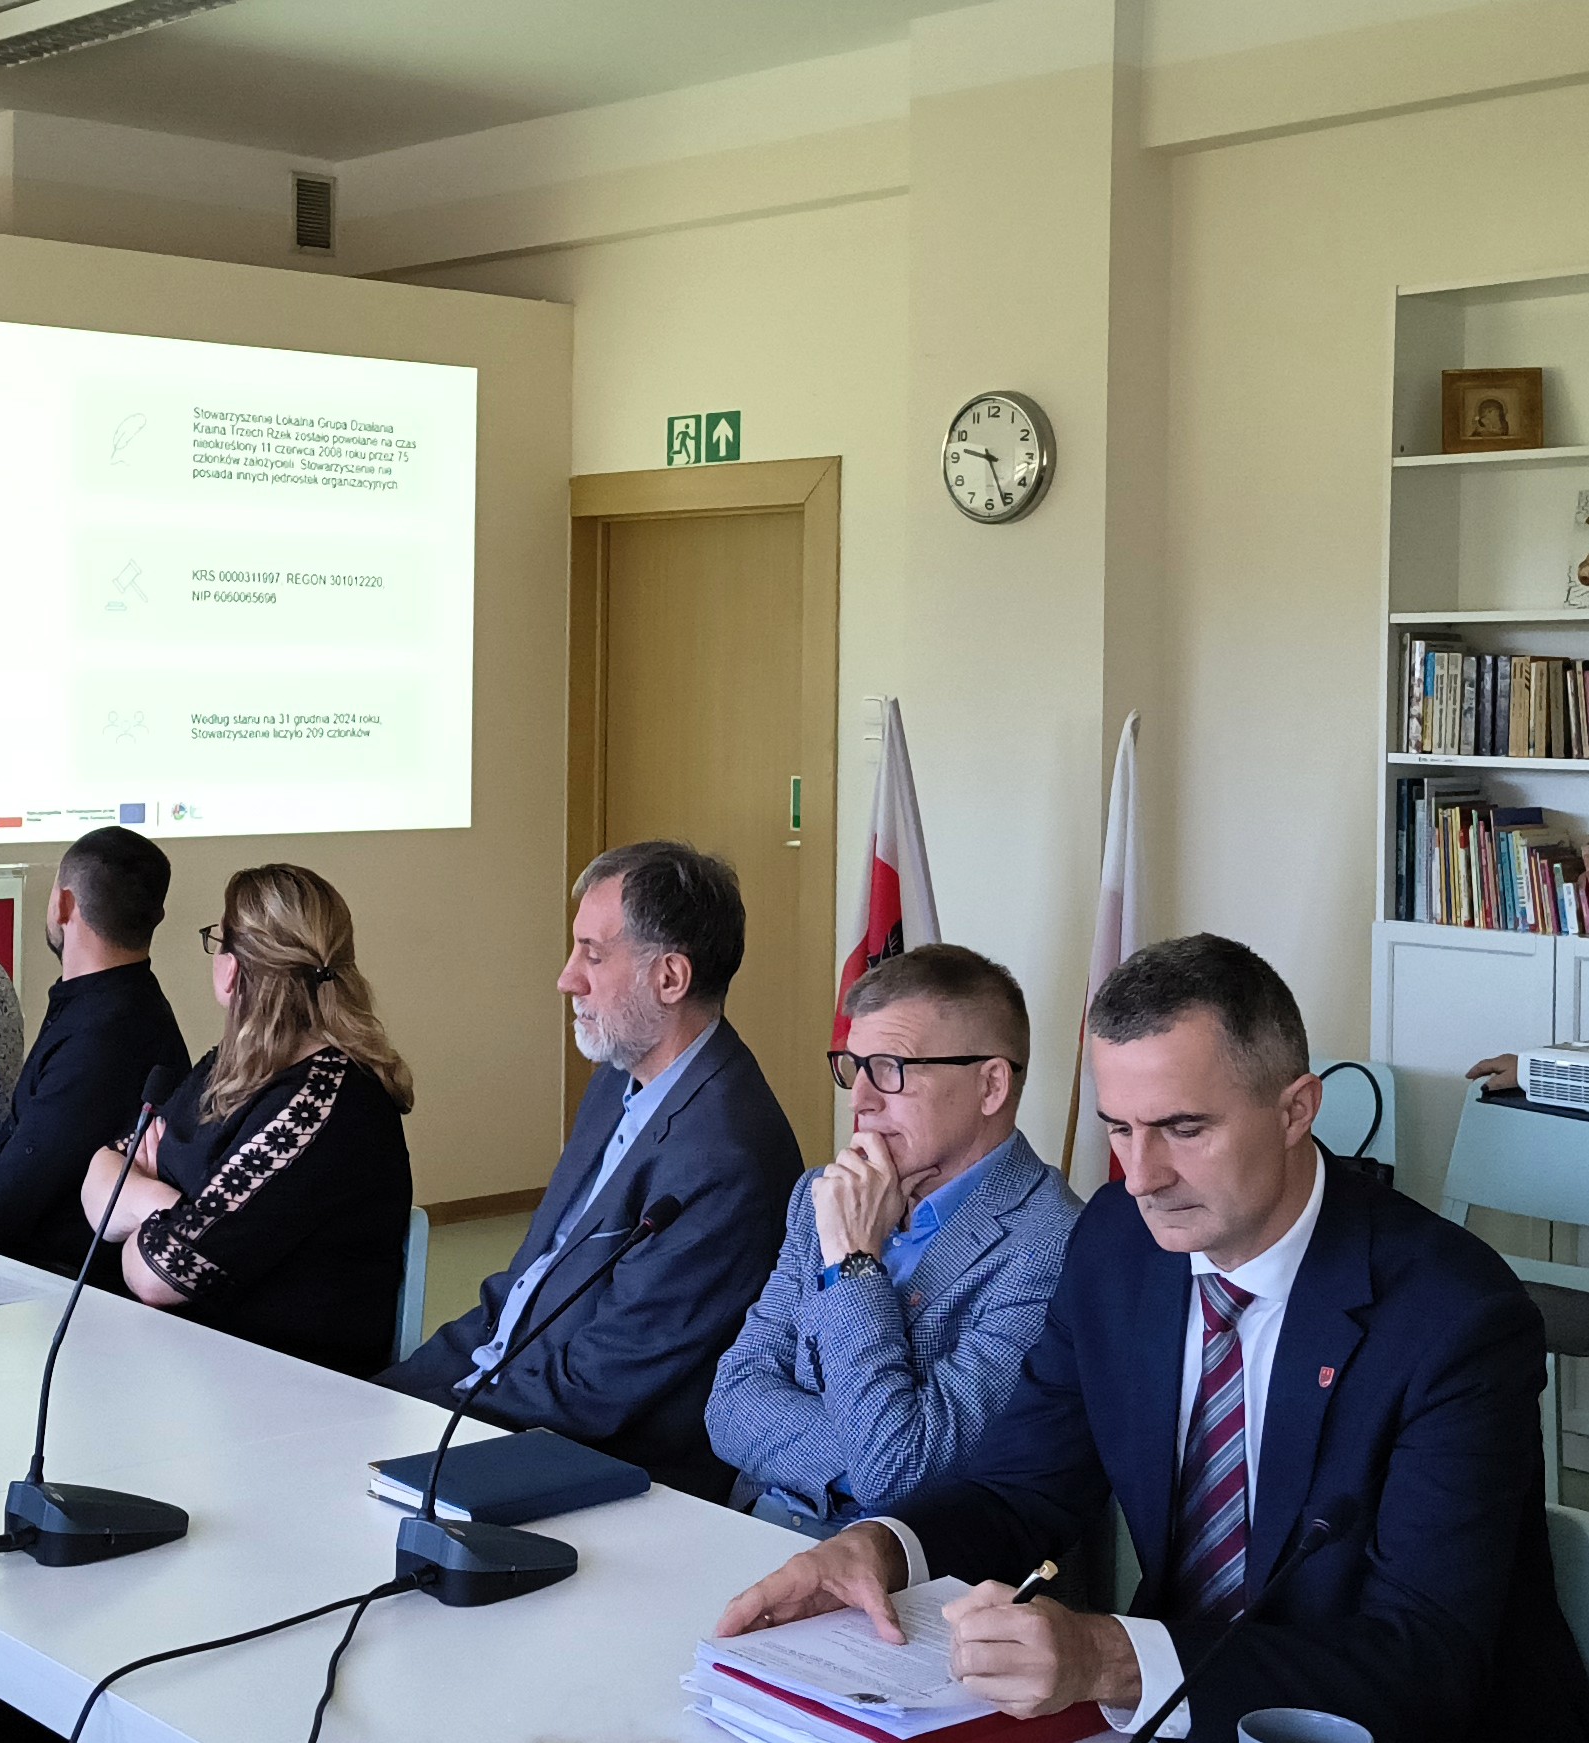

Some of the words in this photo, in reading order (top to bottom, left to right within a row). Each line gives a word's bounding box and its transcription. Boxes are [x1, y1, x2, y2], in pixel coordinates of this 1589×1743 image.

[973, 412, 980, 424] 11
[988, 405, 1001, 418] 12
[1012, 411, 1015, 424] 1
[193, 407, 273, 425] Stowarzyszenie
[276, 414, 315, 428] Lokalna
[317, 417, 348, 431] Grupa
[193, 422, 226, 435] Kraina
[230, 425, 263, 437] Trzech
[267, 427, 291, 440] Rzek
[381, 438, 393, 448] na
[395, 439, 417, 449] czas
[958, 430, 968, 442] 10
[1020, 429, 1030, 441] 2
[262, 442, 271, 453] 11
[275, 444, 315, 457] czerwca
[318, 446, 342, 458] 2008
[345, 449, 366, 460] roku
[369, 451, 395, 463] przez
[398, 451, 409, 463] 75
[951, 452, 960, 463] 9
[300, 458, 375, 475] Stowarzyszenie
[378, 466, 392, 476] nie
[192, 468, 233, 480] posiada
[236, 471, 269, 484] innych
[271, 473, 319, 485] jednostek
[321, 476, 398, 491] organizacyjnych
[955, 475, 965, 487] 8
[1018, 476, 1027, 488] 4
[967, 492, 976, 504] 7
[1003, 492, 1014, 505] 5
[985, 499, 995, 511] 6
[192, 569, 215, 582] KRS
[286, 572, 327, 586] REGON
[192, 590, 211, 602] NIP
[191, 713, 229, 727] Według
[233, 714, 260, 725] stanu
[263, 716, 275, 725] na
[278, 713, 290, 724] 31
[294, 713, 329, 727] grudnia
[333, 713, 356, 725] 2024
[191, 727, 270, 741] Stowarzyszenie
[306, 727, 324, 738] 209
